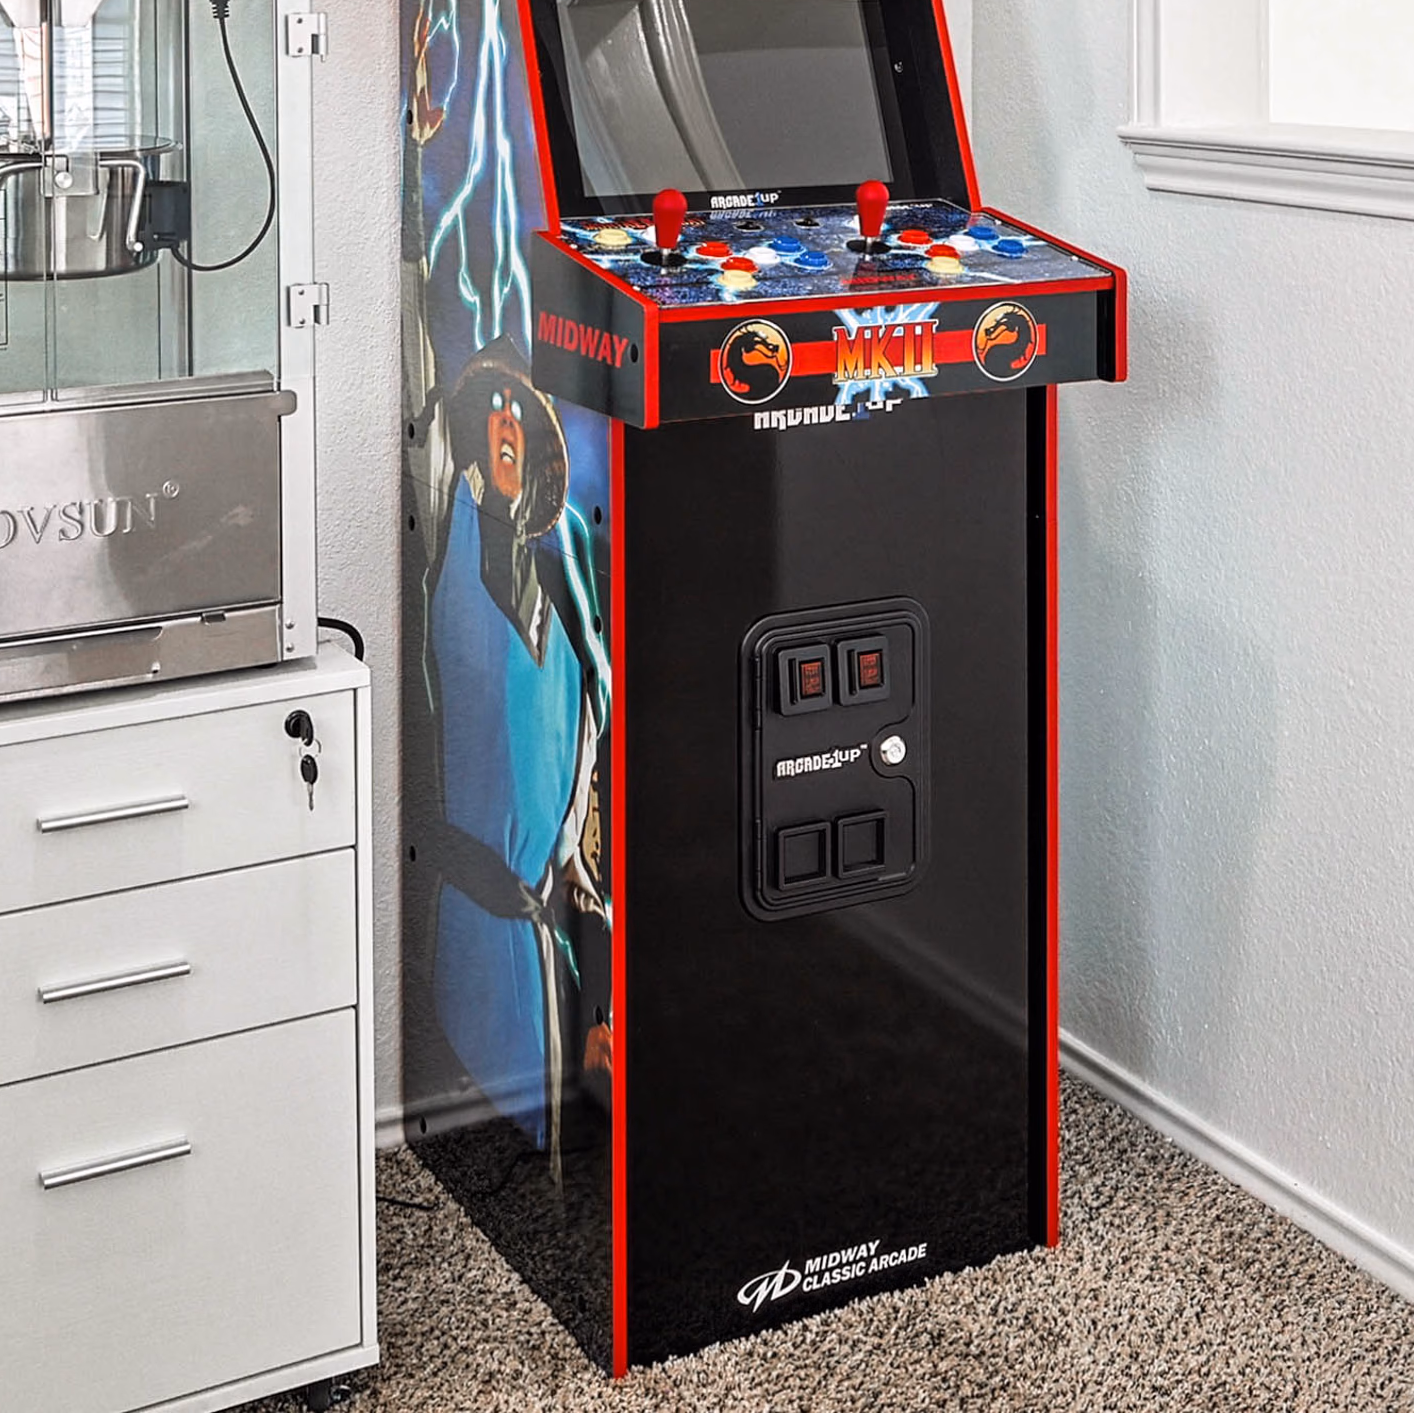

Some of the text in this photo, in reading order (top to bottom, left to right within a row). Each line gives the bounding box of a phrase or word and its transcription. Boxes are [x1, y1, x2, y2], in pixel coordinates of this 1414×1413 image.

[537, 311, 629, 369] MIDWAY
[833, 319, 939, 383] MKII
[802, 1242, 928, 1293] CLASSIC ARCADE
[805, 1239, 881, 1275] MIDWAY
